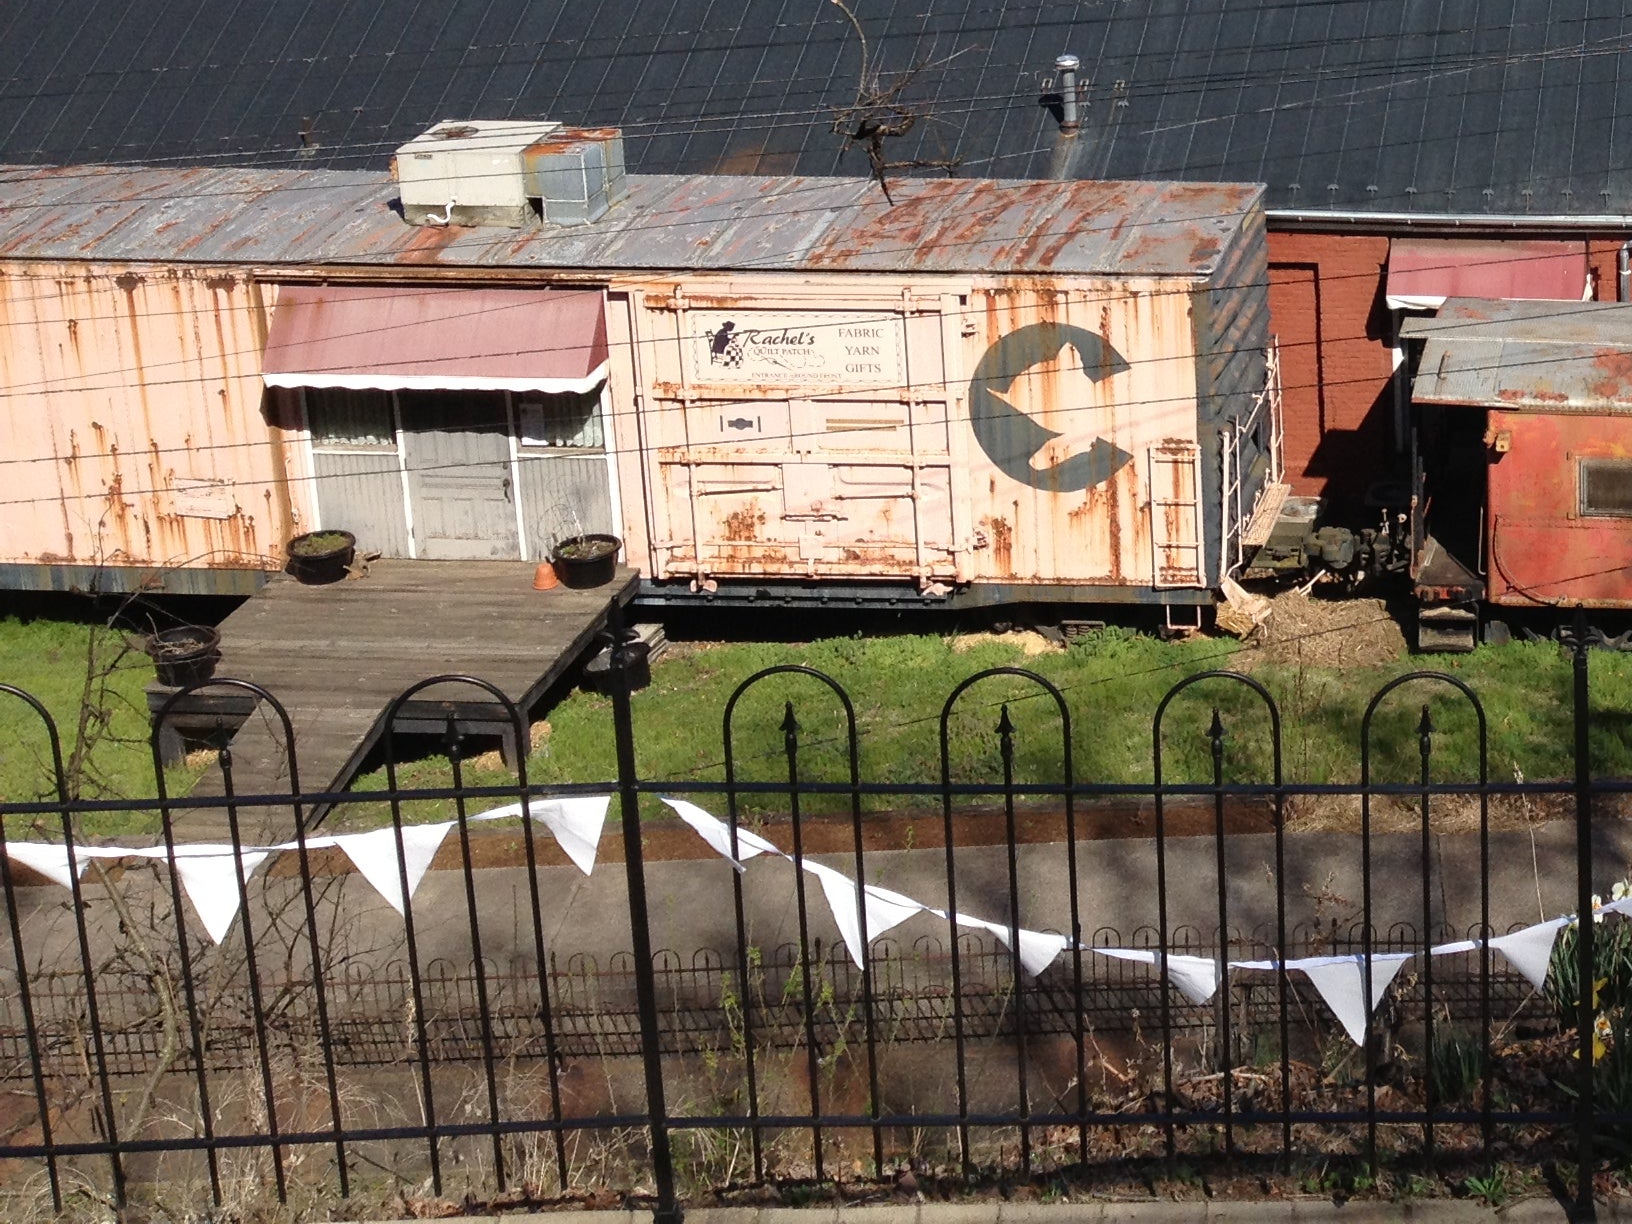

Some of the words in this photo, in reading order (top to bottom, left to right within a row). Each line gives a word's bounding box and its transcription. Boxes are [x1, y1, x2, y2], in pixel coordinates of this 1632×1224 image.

[742, 328, 815, 348] Rachel's
[838, 328, 884, 338] FABRIC
[753, 346, 779, 355] QUILT
[782, 348, 811, 356] PATCH
[845, 345, 880, 356] YARN
[845, 363, 881, 373] GIFTS
